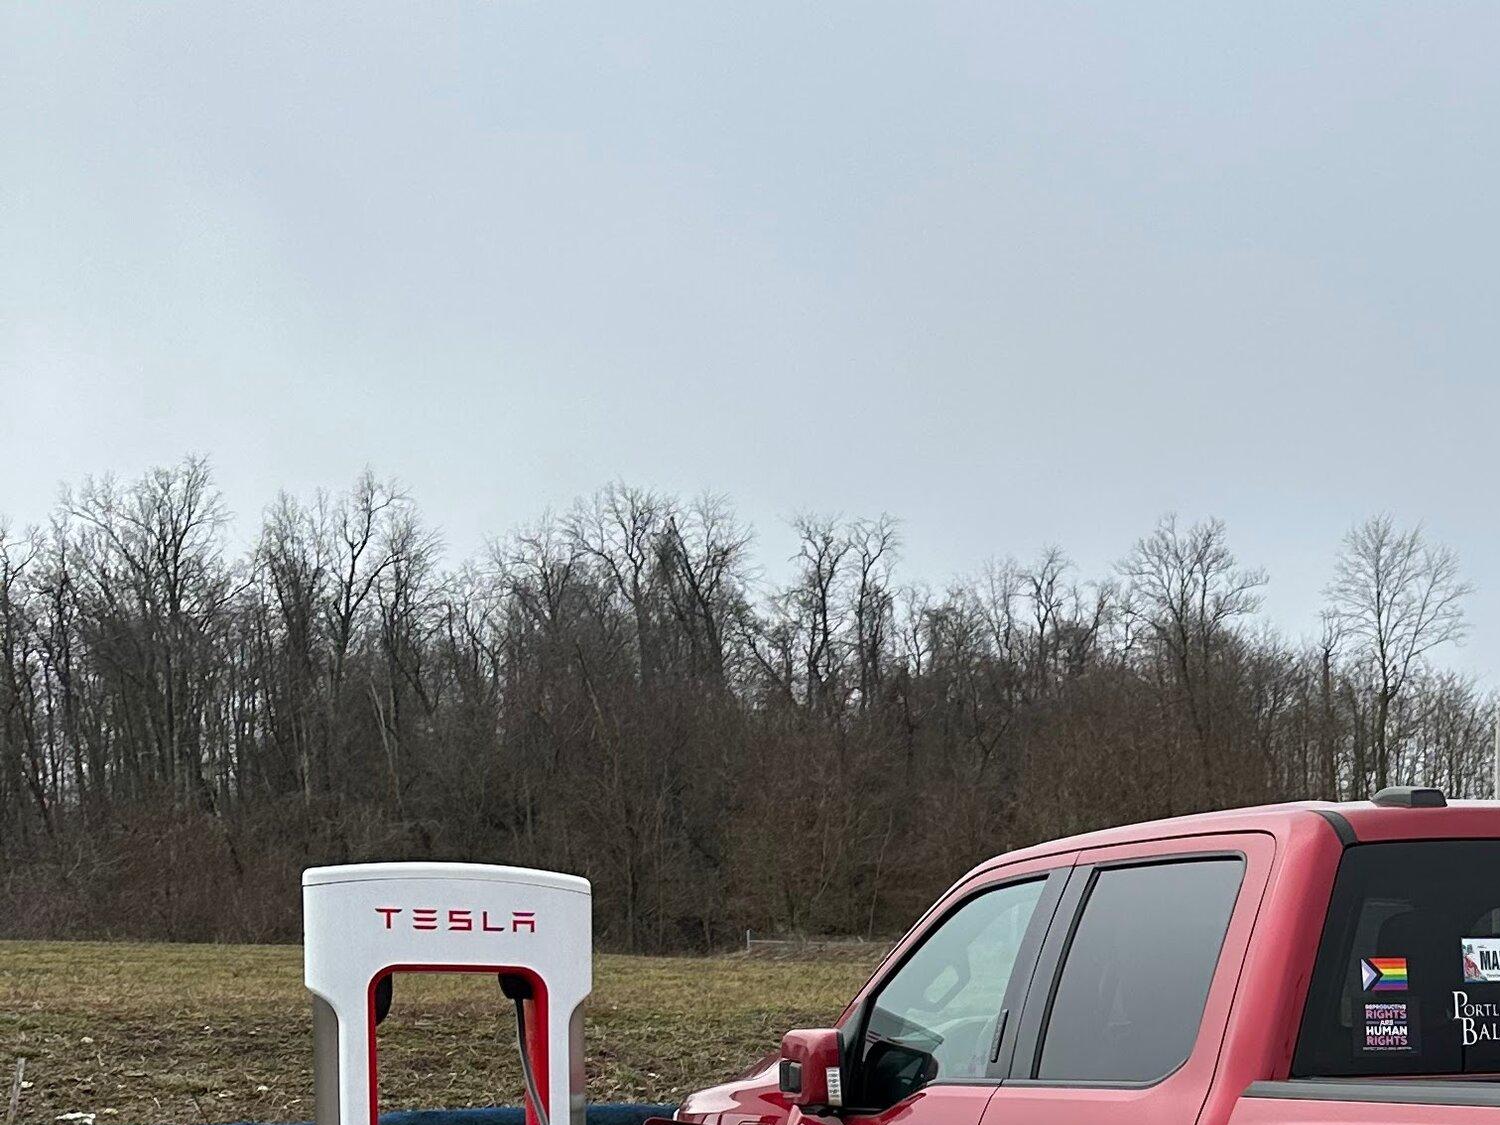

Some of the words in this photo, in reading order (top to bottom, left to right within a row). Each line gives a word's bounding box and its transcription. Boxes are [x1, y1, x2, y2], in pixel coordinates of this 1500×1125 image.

[375, 908, 535, 933] TESLA
[1365, 1009, 1407, 1020] RIGHTS
[1365, 1025, 1408, 1036] HUMAN
[1366, 1035, 1408, 1046] RIGHTS
